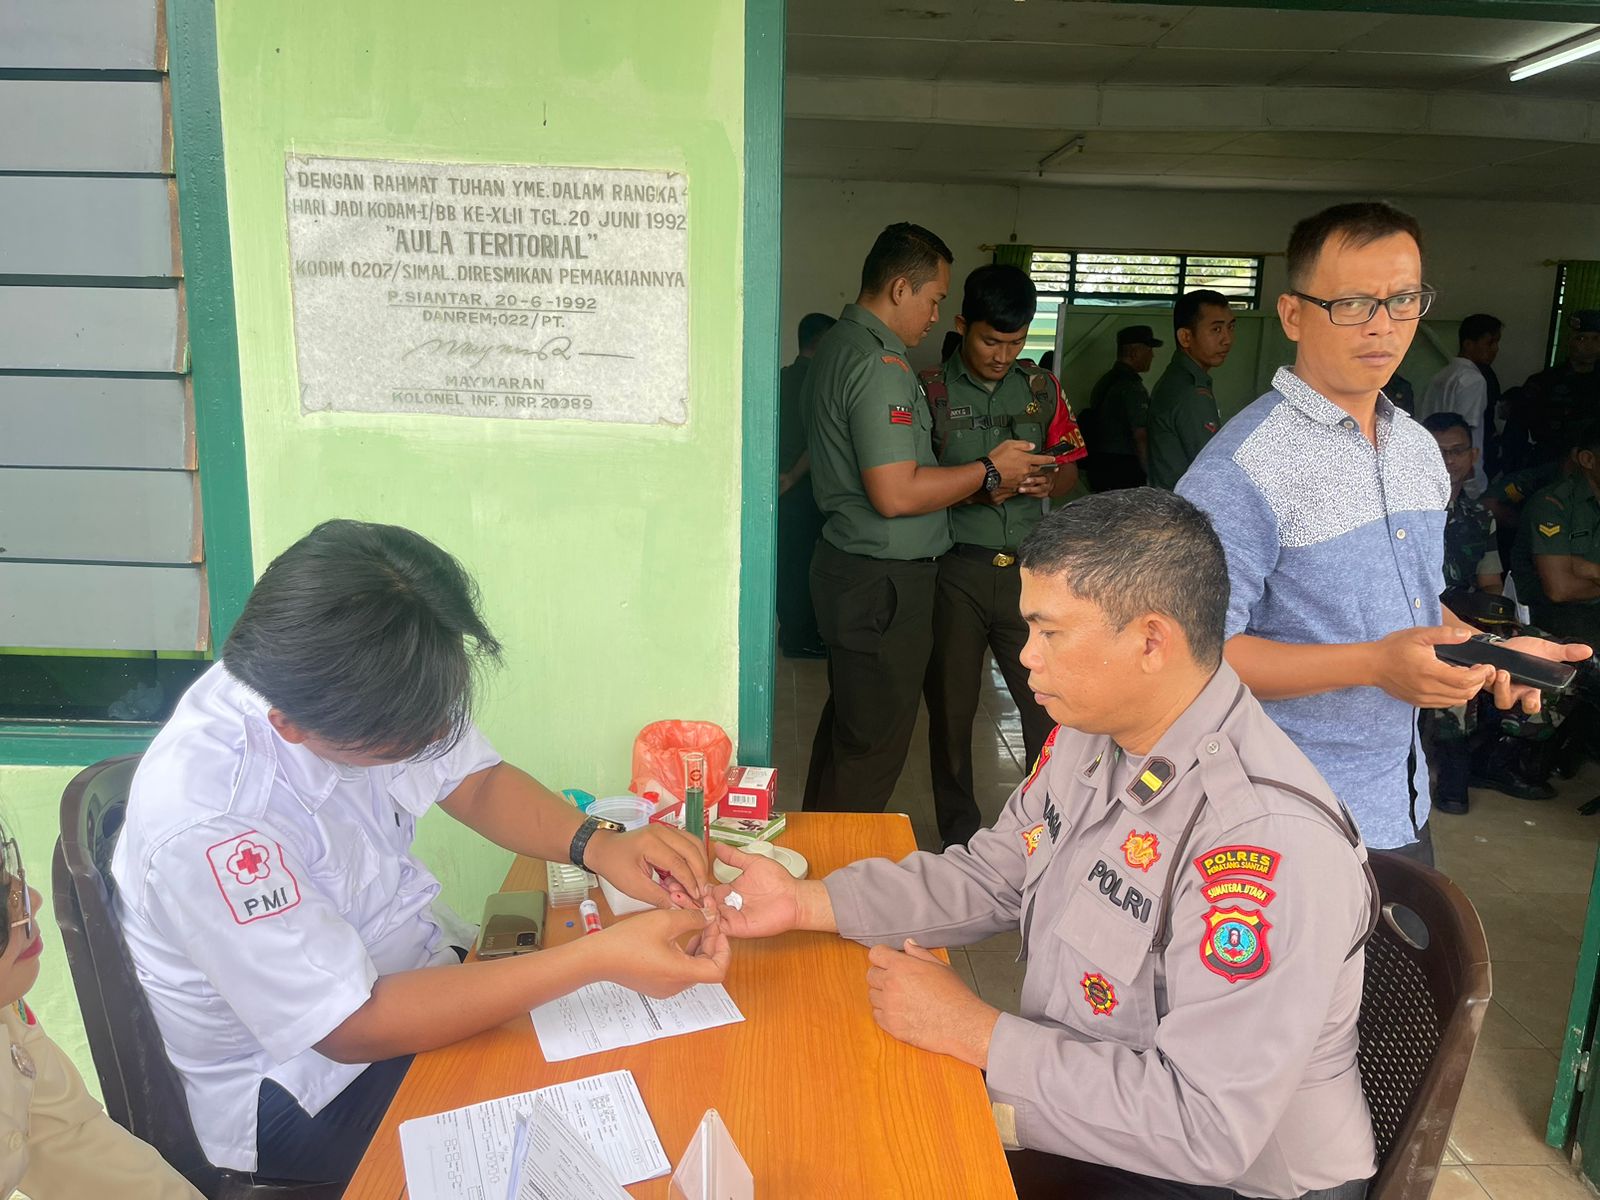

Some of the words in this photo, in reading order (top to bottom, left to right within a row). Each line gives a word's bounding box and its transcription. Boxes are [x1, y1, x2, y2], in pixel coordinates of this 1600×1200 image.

[297, 171, 364, 191] DENGAN
[373, 174, 438, 194] RAHMAT
[447, 177, 505, 197] TUHAN
[612, 184, 678, 204] RANGKA
[292, 198, 326, 216] HARI
[330, 200, 363, 217] JADI
[463, 206, 522, 225] KE-XLII
[598, 211, 640, 229] JUNI
[646, 212, 687, 231] 1992
[296, 259, 345, 278] KODIM
[559, 269, 685, 288] PEMAKAIANNYA
[445, 375, 545, 391] MAYMARAN
[392, 391, 464, 406] KOLONEL
[471, 394, 498, 407] INF.
[1204, 851, 1271, 869] POLRES
[243, 887, 288, 917] PMI
[1088, 859, 1152, 924] POLRI
